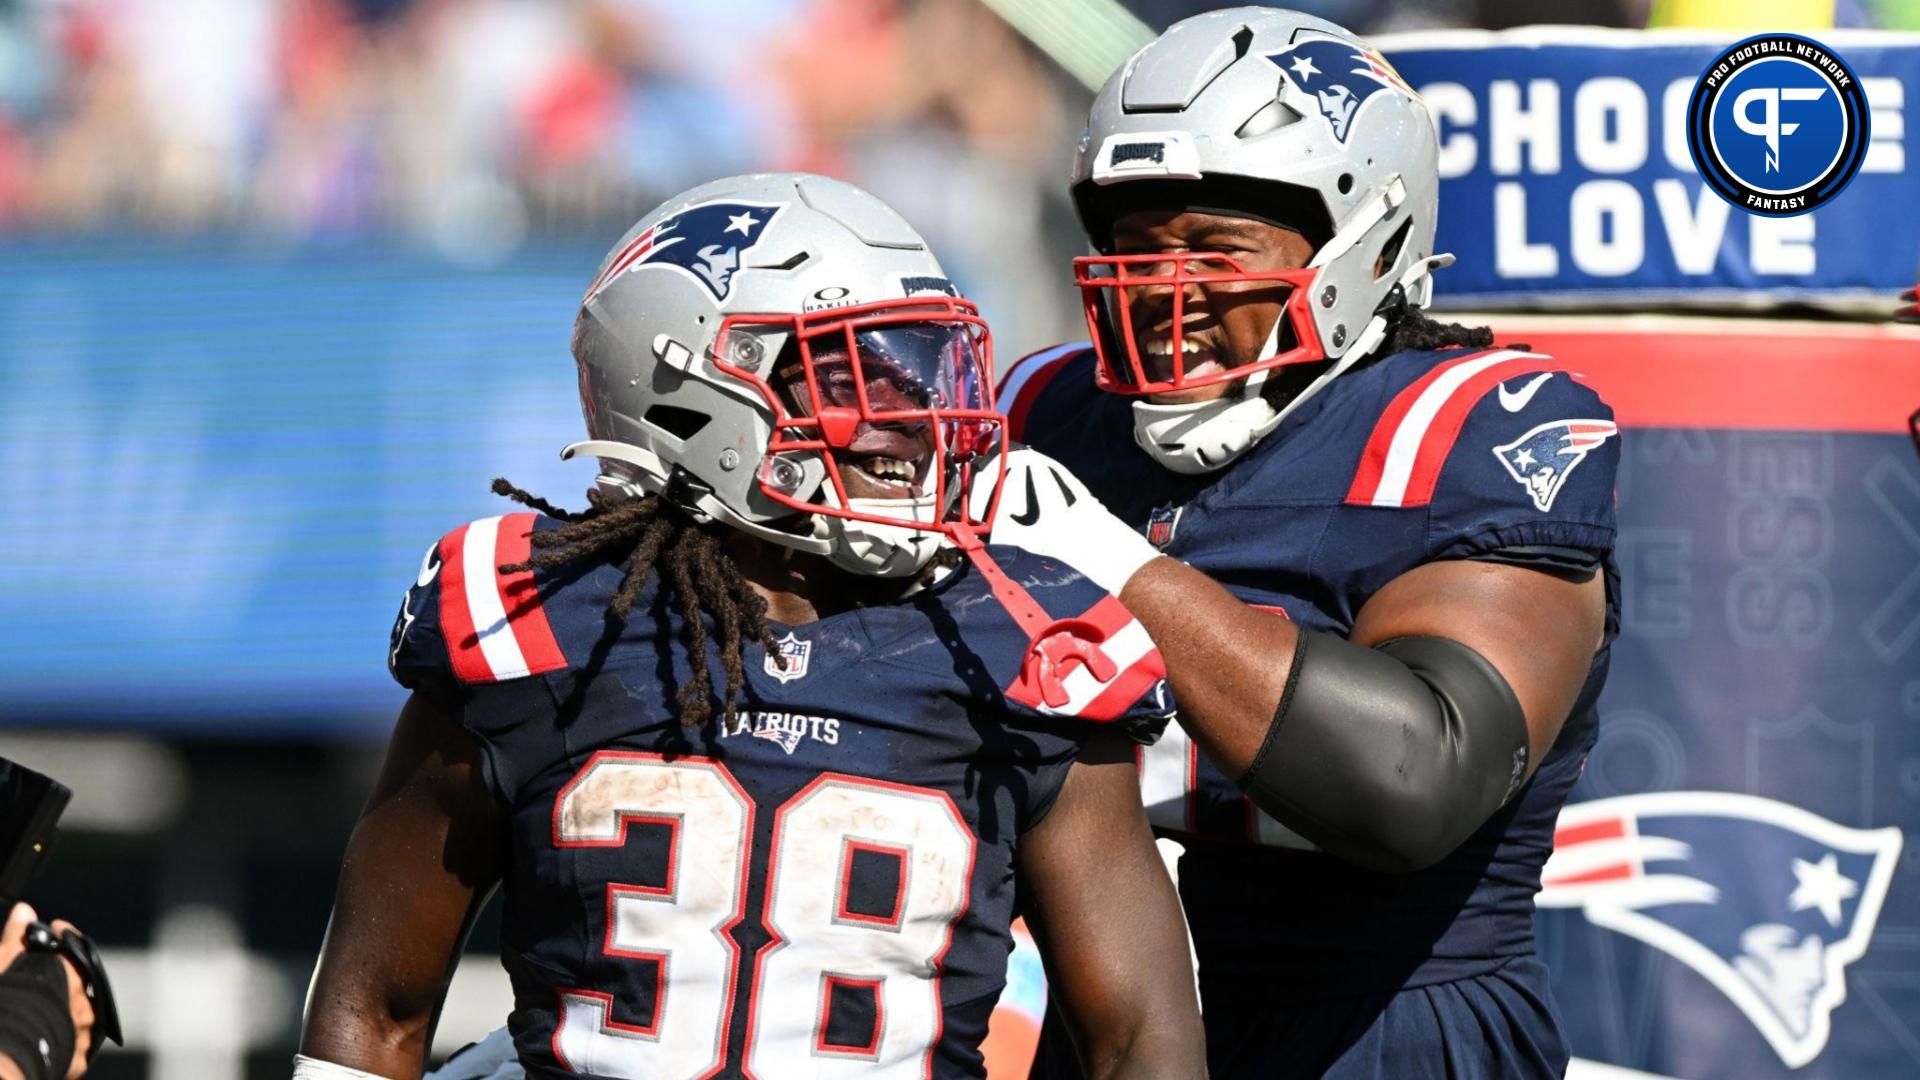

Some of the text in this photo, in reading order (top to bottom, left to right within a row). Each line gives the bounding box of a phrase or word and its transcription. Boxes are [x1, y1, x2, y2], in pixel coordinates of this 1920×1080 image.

[1418, 76, 1905, 178] CHOE
[1494, 179, 1816, 278] LOVE
[552, 750, 977, 1080] 38
